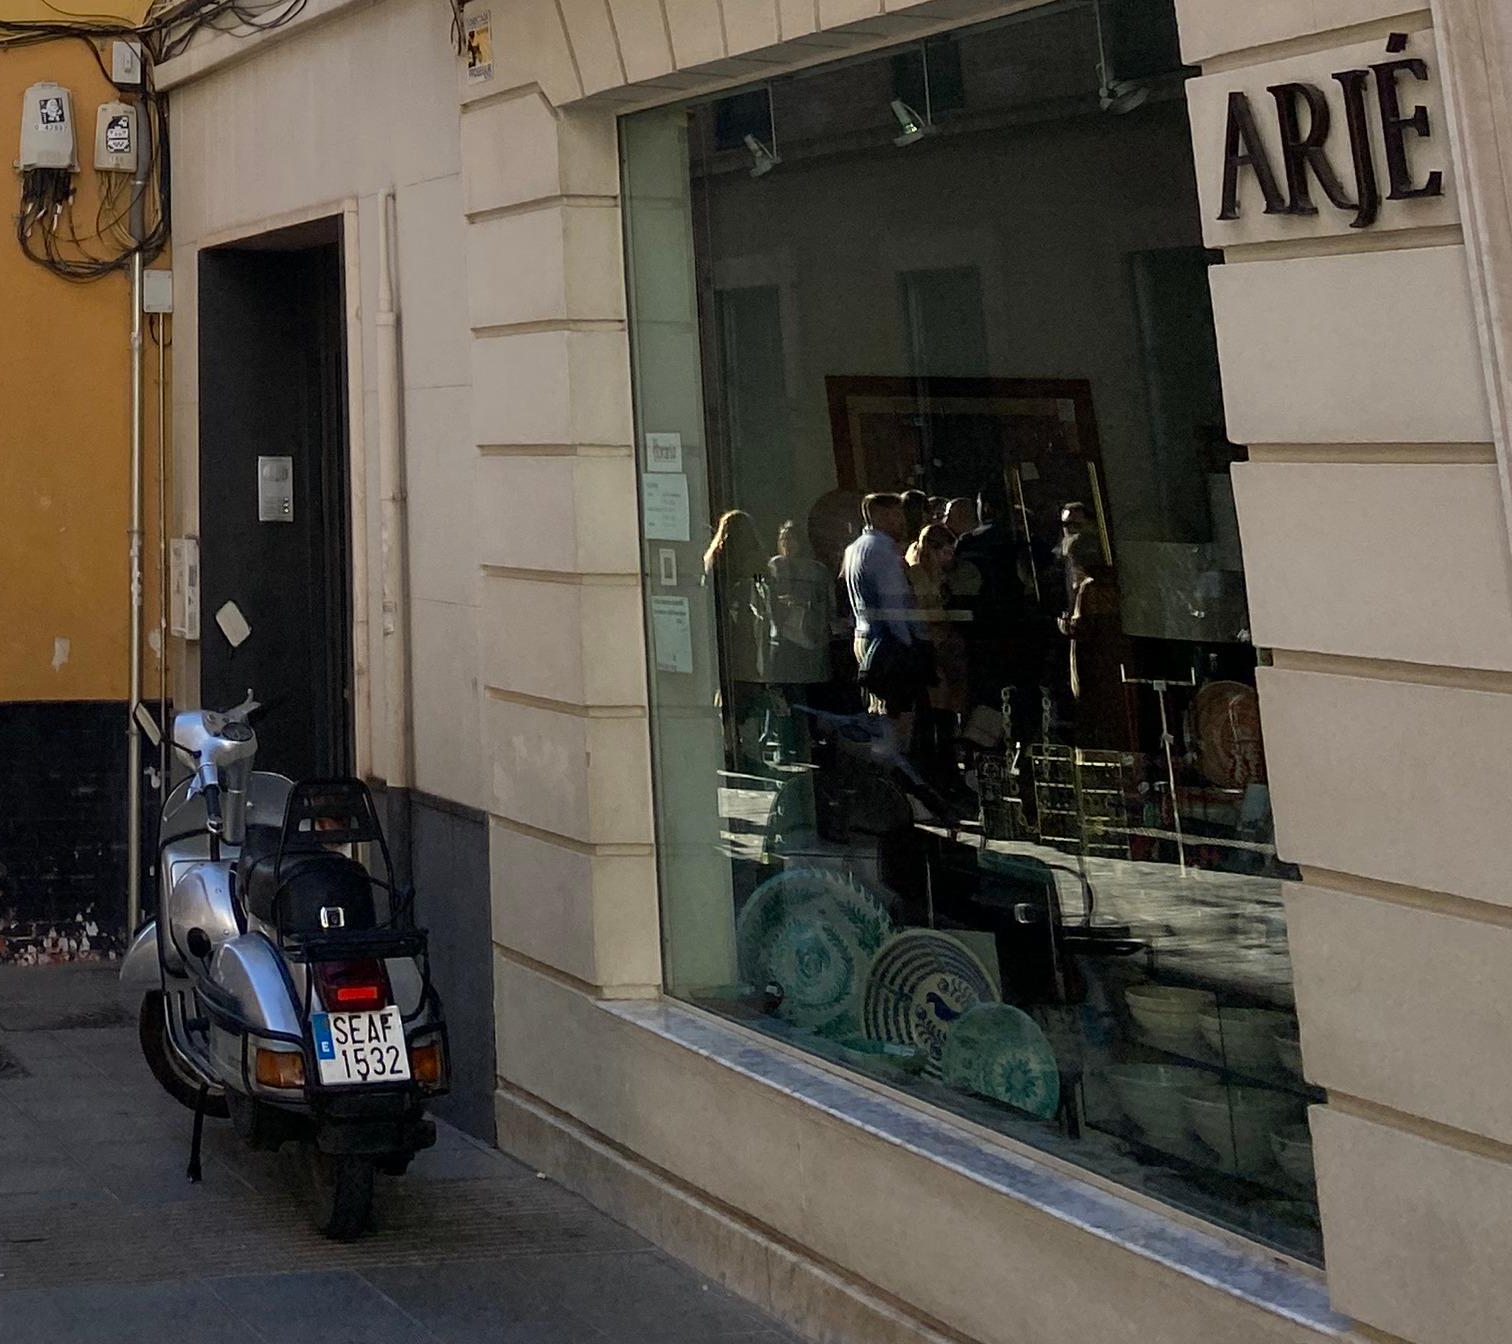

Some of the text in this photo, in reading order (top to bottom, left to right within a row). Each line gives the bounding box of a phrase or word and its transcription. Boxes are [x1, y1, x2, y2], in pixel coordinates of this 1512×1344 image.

[1216, 32, 1444, 229] ARJÉ
[333, 1012, 393, 1045] SEAF
[320, 1041, 330, 1053] E
[341, 1045, 403, 1079] 1532
